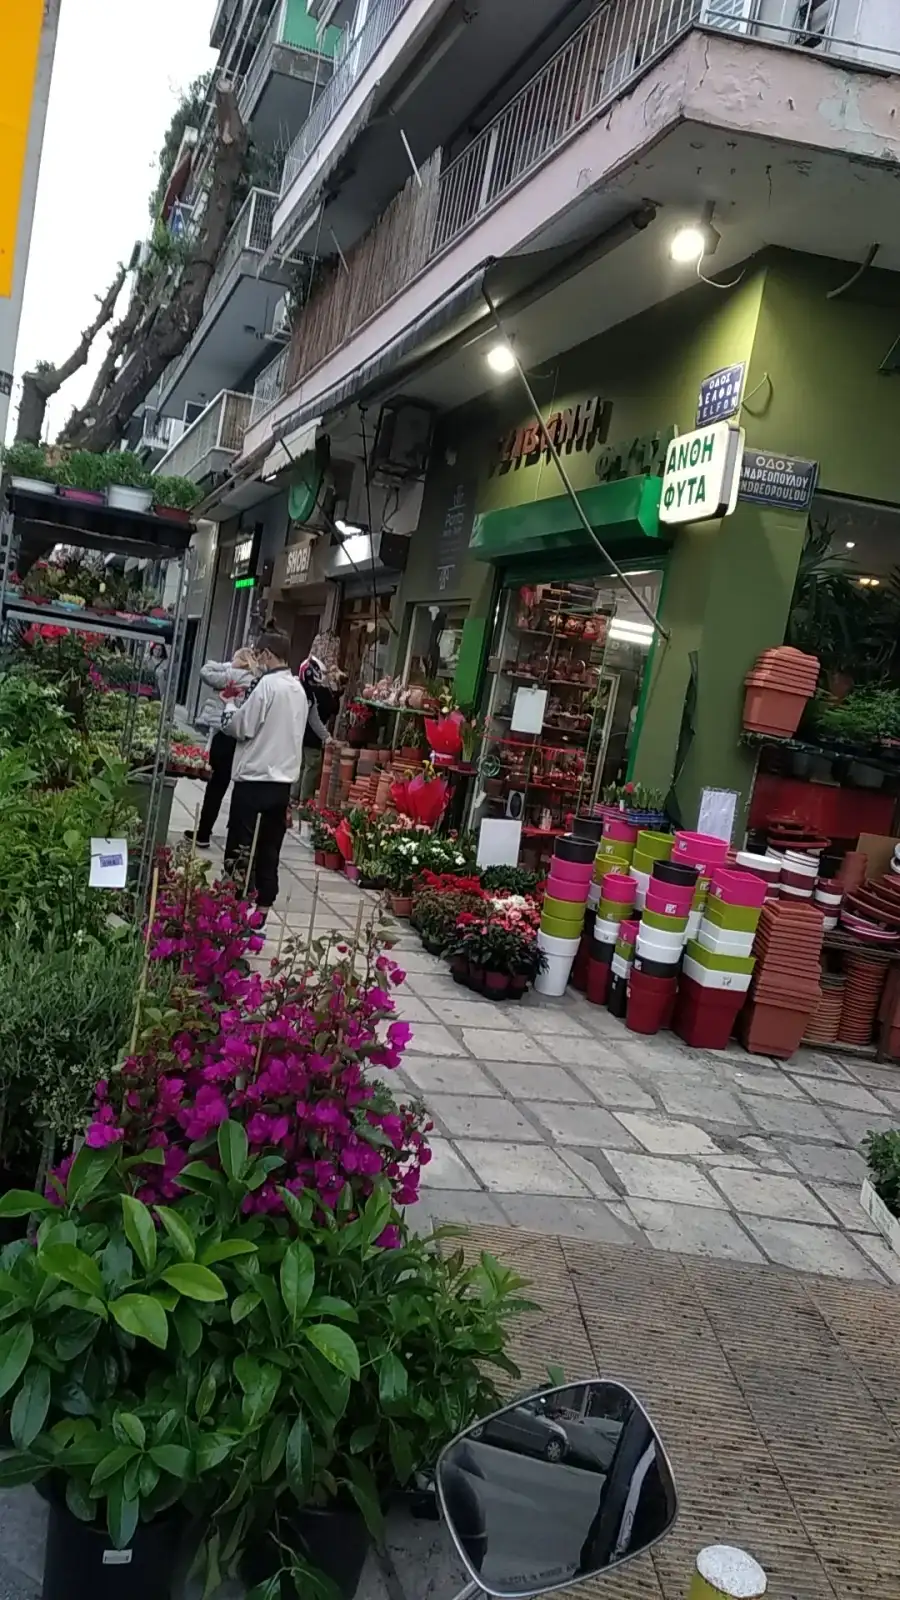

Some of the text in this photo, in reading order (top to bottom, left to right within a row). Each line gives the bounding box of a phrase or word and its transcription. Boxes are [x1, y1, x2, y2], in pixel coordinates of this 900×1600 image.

[709, 372, 732, 390] ΟΔΟΣ
[667, 433, 715, 475] ΑΝΘΗ
[755, 455, 795, 473] ΟΔΟΣ
[664, 475, 706, 511] ΦΥΤΑ
[739, 479, 807, 502] NDREOPOULOU
